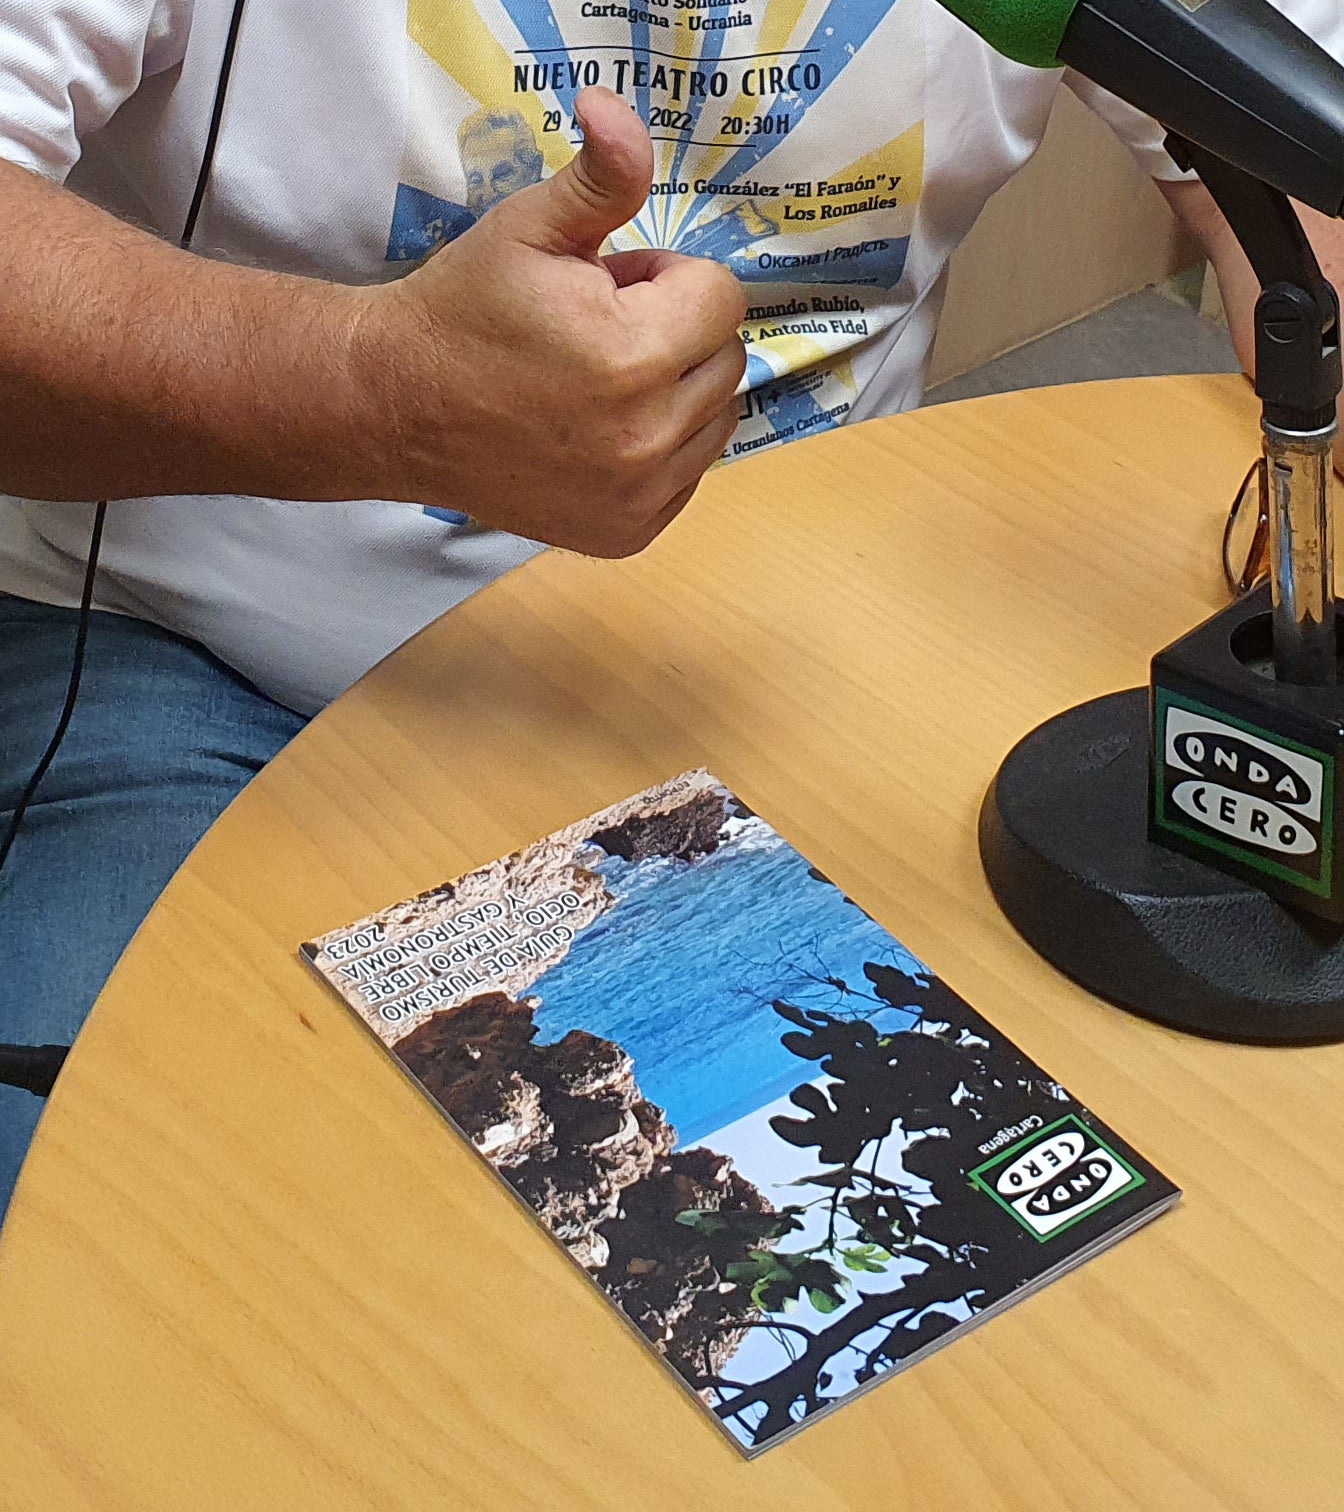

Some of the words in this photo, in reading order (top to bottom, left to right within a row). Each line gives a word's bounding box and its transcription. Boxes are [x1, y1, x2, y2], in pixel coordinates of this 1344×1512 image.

[581, 2, 670, 29] Cartagena
[688, 11, 753, 31] Ucrania
[513, 59, 601, 93] NUEVO
[612, 59, 728, 102] TEATRO
[741, 63, 821, 97] CIRCO
[542, 110, 562, 133] 29
[649, 106, 693, 132] 2022
[650, 178, 689, 196] onio
[694, 178, 781, 197] González
[887, 176, 902, 191] y
[783, 204, 816, 222] Los
[820, 194, 897, 220] Romalíes
[744, 298, 808, 322] rnando
[741, 329, 756, 344] &
[759, 319, 828, 341] Antonio
[828, 318, 869, 336] Fidel
[796, 402, 850, 432] Cartagena
[1184, 735, 1299, 800] ONDA
[1192, 786, 1297, 847] CERO
[507, 892, 526, 913] Y
[513, 891, 581, 927] OCIO,
[324, 924, 386, 961] 2023
[339, 901, 504, 981] GASTRONOMÍA
[429, 923, 519, 971] TIEMPO
[515, 924, 574, 962] GUÍA
[485, 953, 518, 977] DE
[360, 966, 431, 1003] LIBRE
[380, 973, 486, 1022] TURISMO
[977, 1114, 1044, 1155] Cartagena
[1008, 1141, 1076, 1187] CERO
[1032, 1162, 1108, 1211] ONDA
